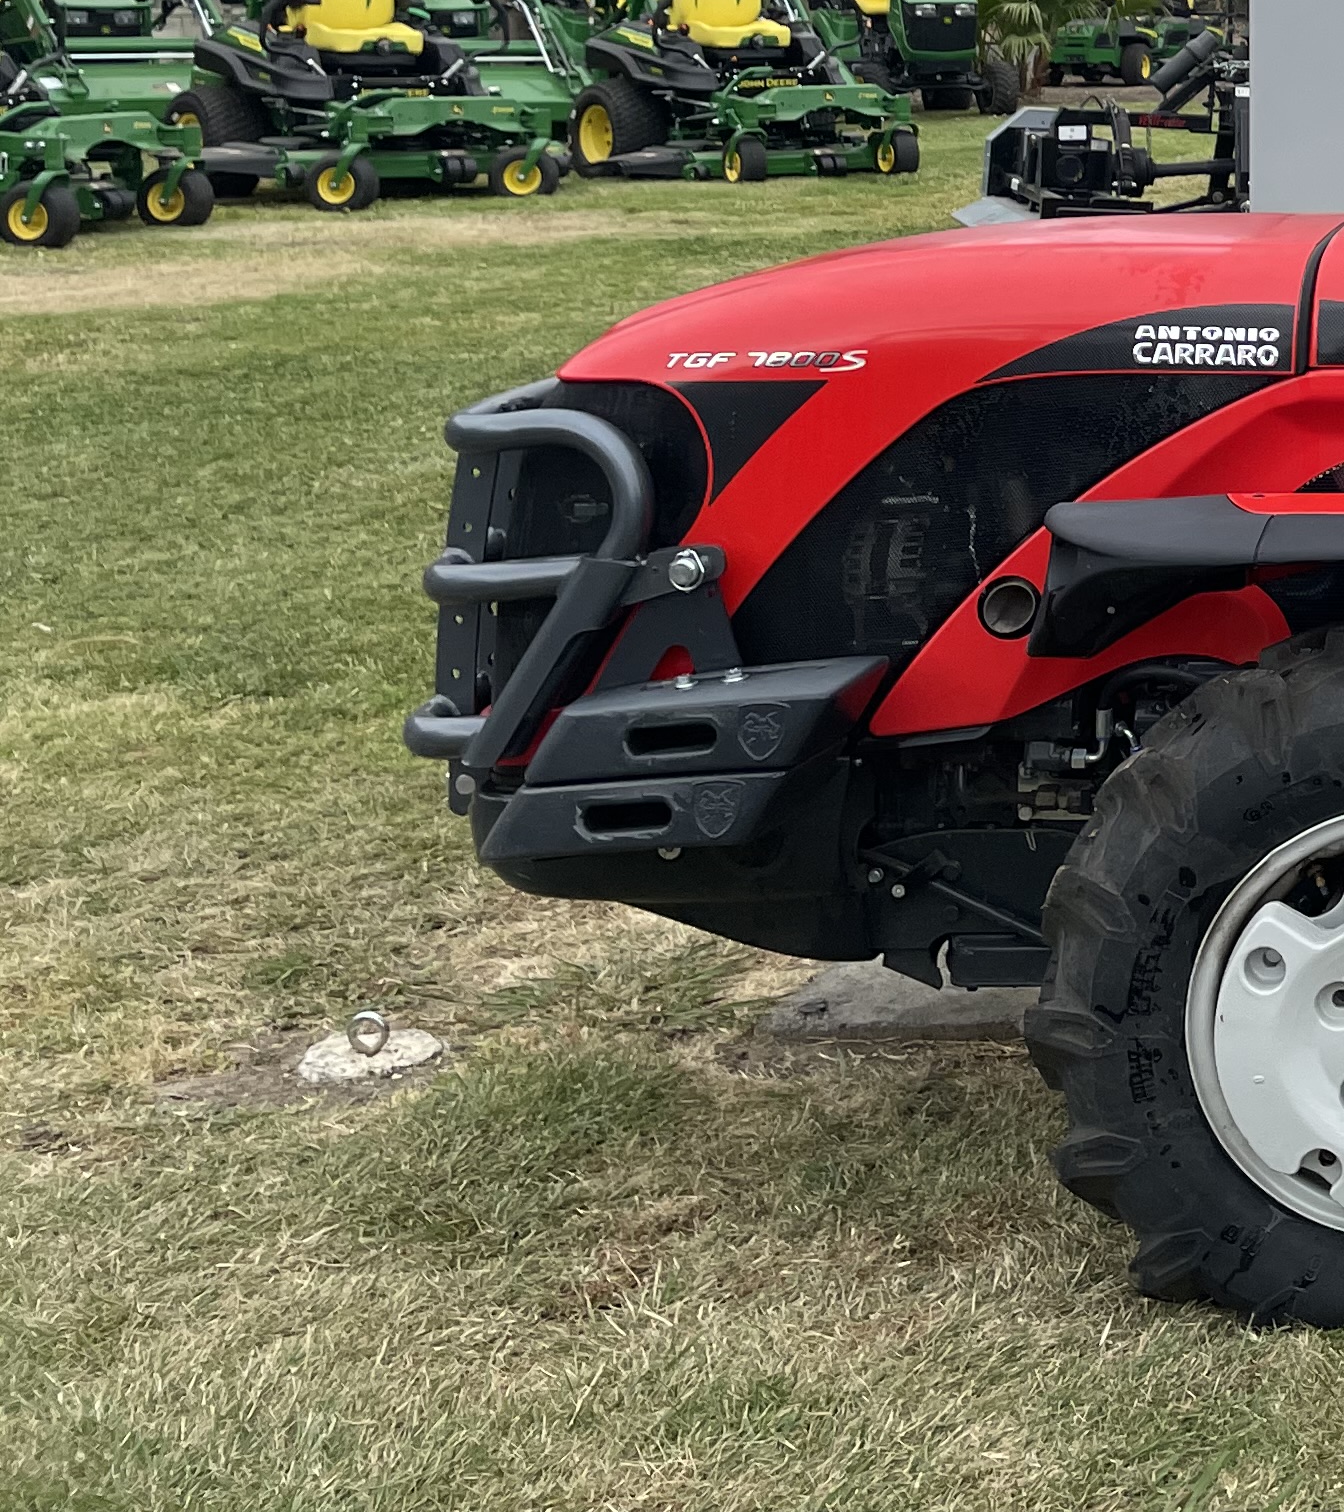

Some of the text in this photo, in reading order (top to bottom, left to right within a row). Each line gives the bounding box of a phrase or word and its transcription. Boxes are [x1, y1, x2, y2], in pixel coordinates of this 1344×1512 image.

[1134, 324, 1280, 342] ANTONIO
[666, 349, 869, 373] TGF 7800S
[1132, 342, 1280, 367] CARRARO
